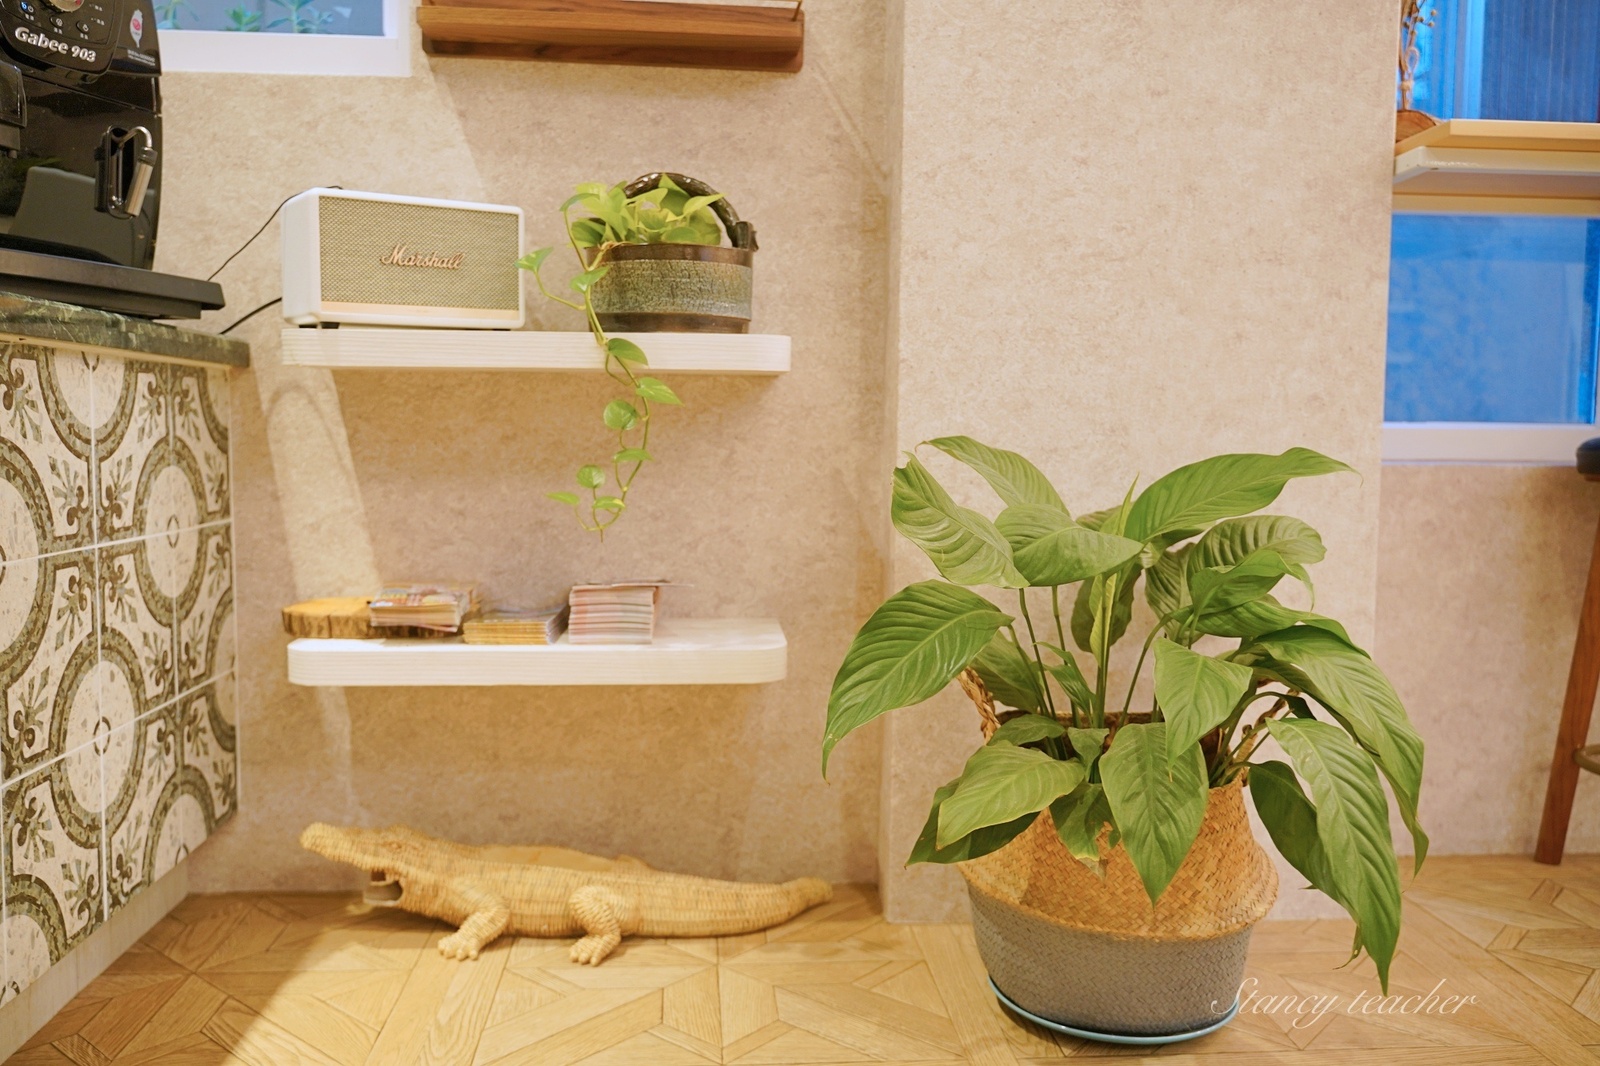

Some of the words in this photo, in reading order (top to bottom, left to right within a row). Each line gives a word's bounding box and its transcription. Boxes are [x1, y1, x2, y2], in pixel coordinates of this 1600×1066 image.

[14, 26, 69, 54] Gabee
[71, 45, 96, 62] 903
[380, 243, 465, 269] Marshall
